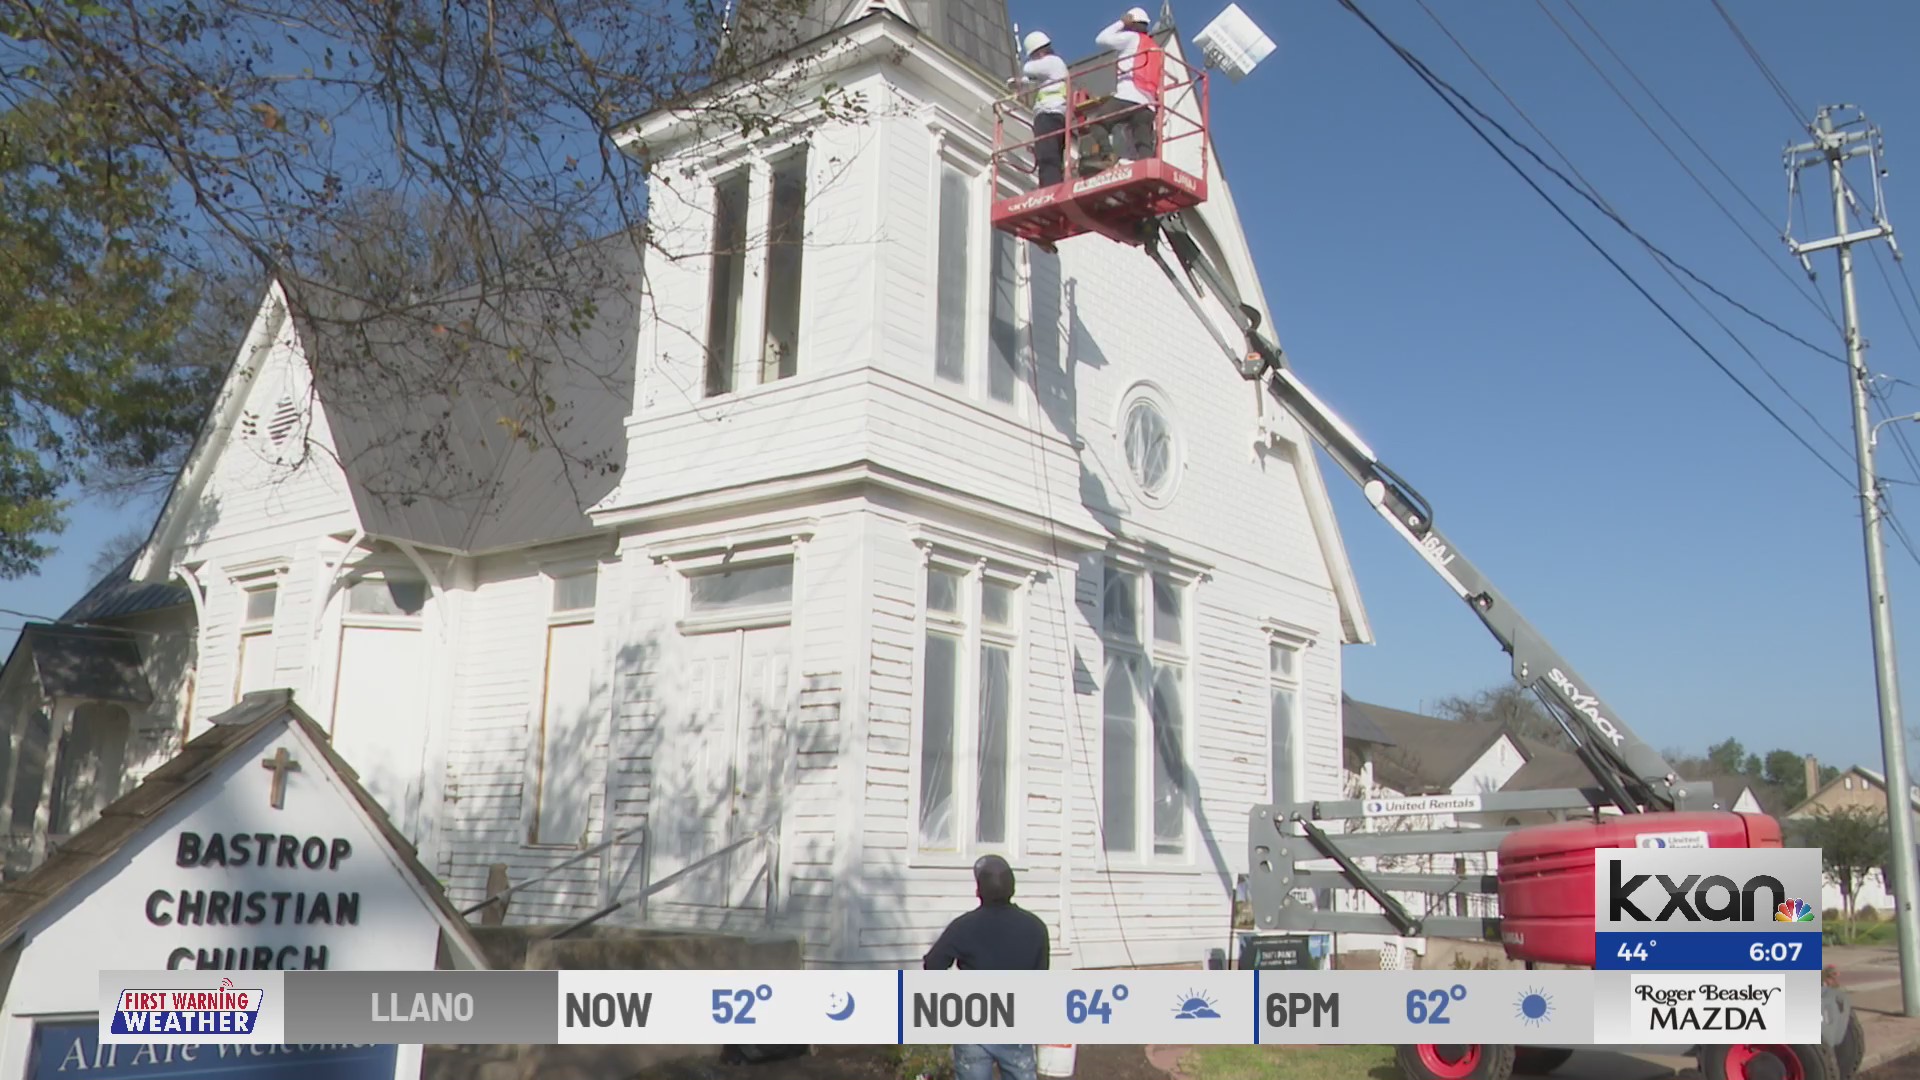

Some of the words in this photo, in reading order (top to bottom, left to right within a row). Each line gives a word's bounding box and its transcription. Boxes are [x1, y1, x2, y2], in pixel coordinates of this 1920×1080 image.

[1548, 668, 1624, 747] SKYJACK
[1386, 800, 1425, 811] United
[1430, 798, 1475, 809] Rentals
[176, 832, 352, 870] BASTROP
[146, 889, 360, 926] CHRISTIAN
[167, 946, 330, 970] CHURCH
